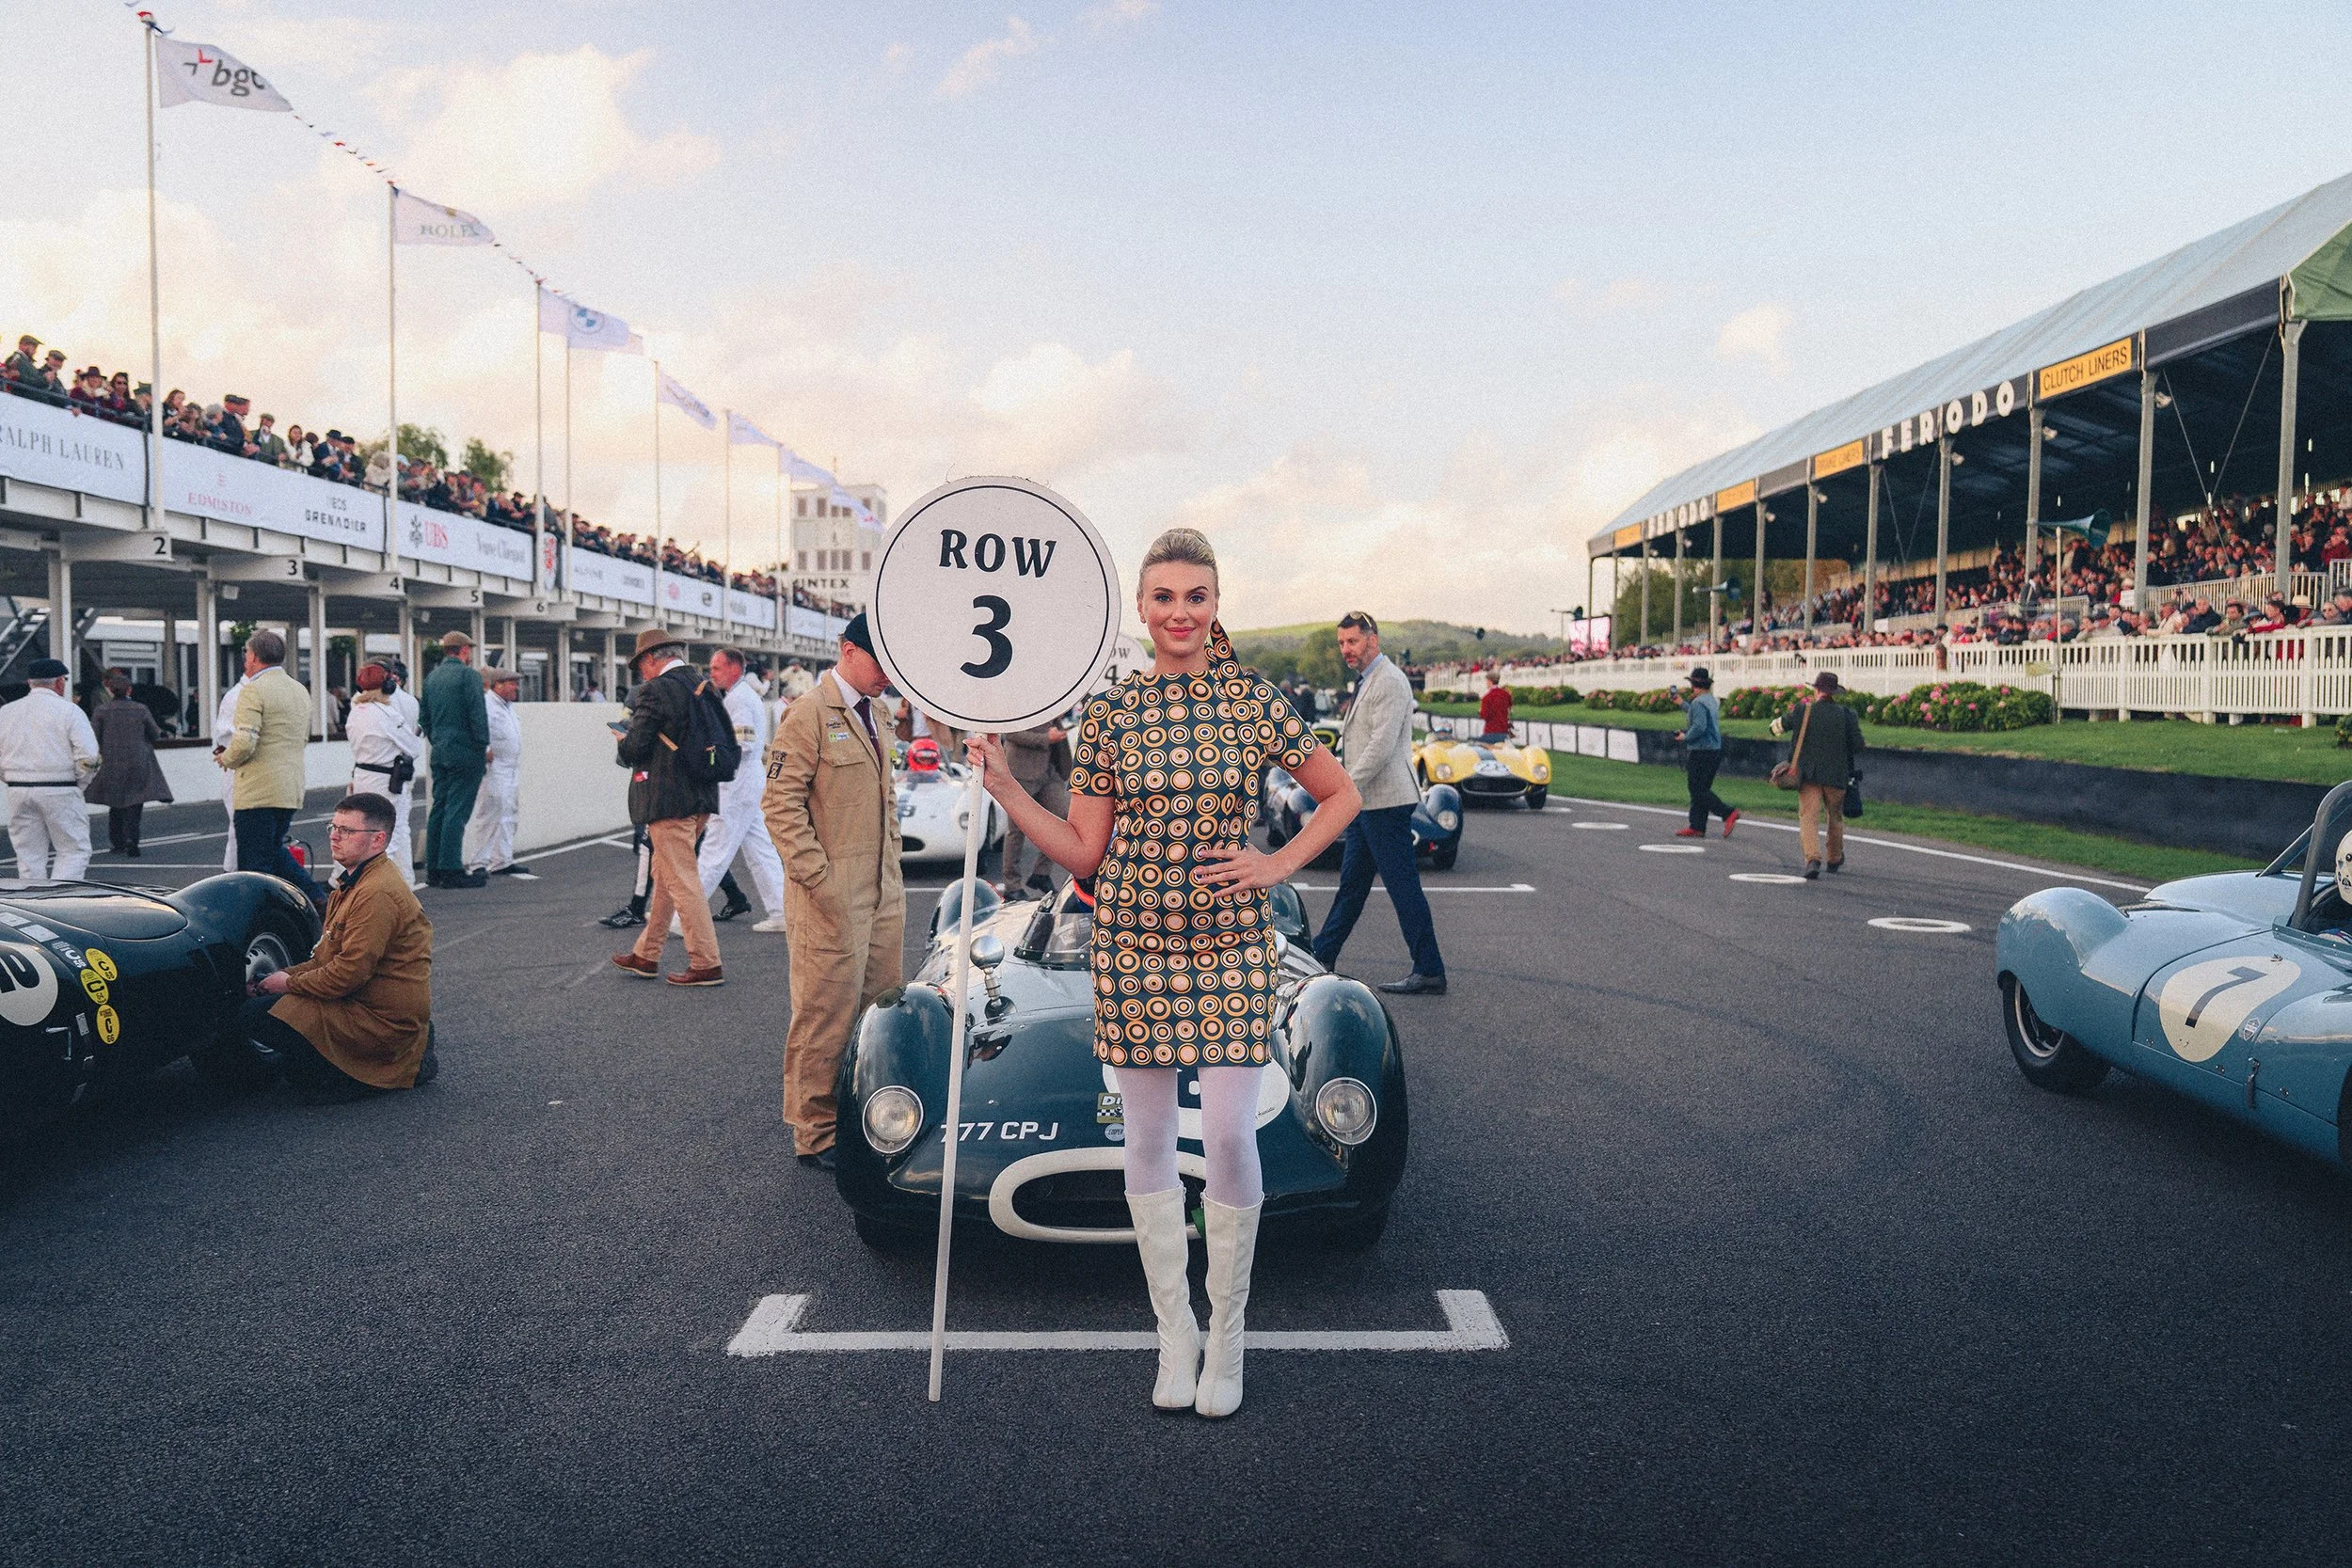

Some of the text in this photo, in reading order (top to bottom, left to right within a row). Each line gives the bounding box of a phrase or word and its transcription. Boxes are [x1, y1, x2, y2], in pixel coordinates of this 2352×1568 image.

[2042, 346, 2127, 391] CLUTCH LINERS
[1882, 380, 2014, 460] FERODO
[0, 425, 124, 469] ALPH LAUREN
[187, 492, 253, 517] EDMISTON
[305, 509, 367, 532] GRENADIER
[153, 536, 167, 555] 2
[423, 520, 449, 549] UBS
[939, 529, 1057, 578] ROW
[287, 560, 298, 576] 3
[389, 577, 400, 591] 4
[471, 590, 480, 603] 5
[536, 602, 545, 612] 6
[959, 594, 1013, 679] 3
[1104, 664, 1120, 686] 4
[2185, 966, 2268, 1029] 7
[1000, 1121, 1059, 1141] CPJ
